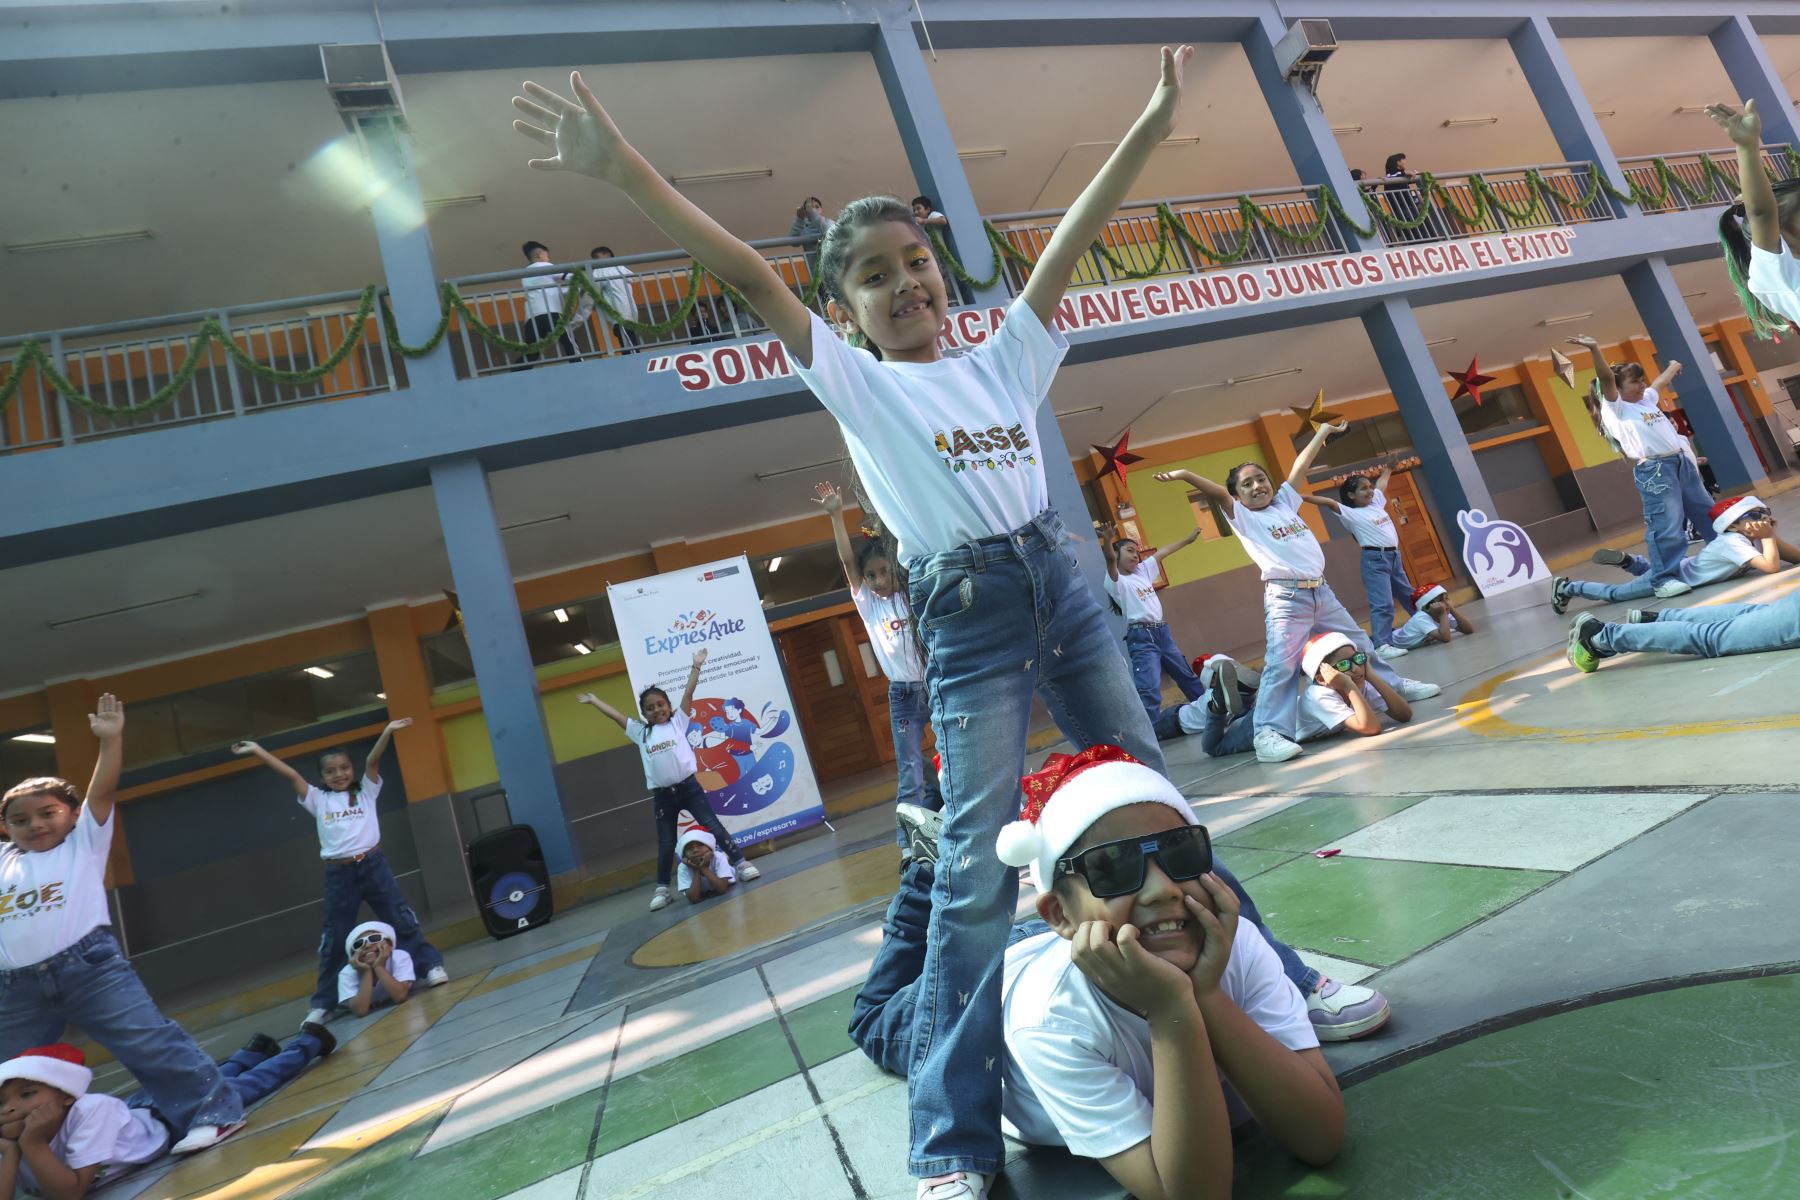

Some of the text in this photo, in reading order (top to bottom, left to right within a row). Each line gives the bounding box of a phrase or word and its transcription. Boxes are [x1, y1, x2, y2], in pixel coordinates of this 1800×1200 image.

[647, 339, 790, 392] "SOM
[1053, 272, 1261, 332] NAVEGANDO
[1265, 254, 1385, 298] JUNTOS
[1385, 243, 1470, 280] HACIA
[1470, 241, 1503, 268] EL
[644, 618, 746, 656] ExpresArte
[723, 655, 757, 669] emocional
